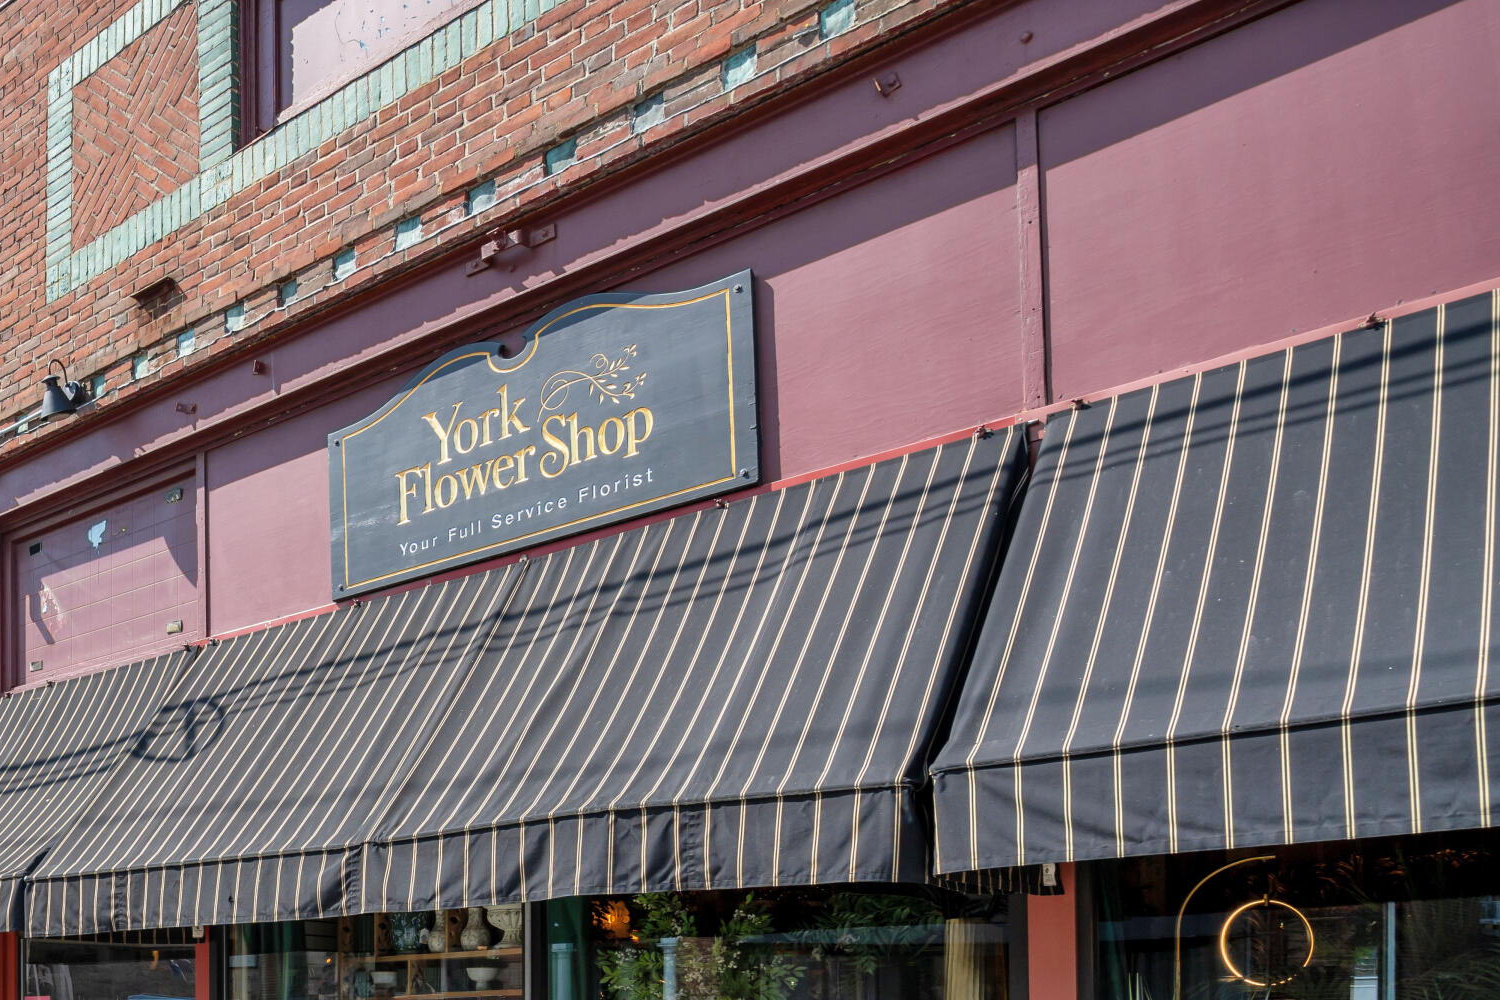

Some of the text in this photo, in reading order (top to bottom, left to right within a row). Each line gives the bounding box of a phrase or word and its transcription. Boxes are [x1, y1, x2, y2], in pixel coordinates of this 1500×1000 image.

[395, 405, 654, 526] Flower Shop
[421, 384, 531, 466] York
[400, 467, 654, 557] Your Full Service Florist
